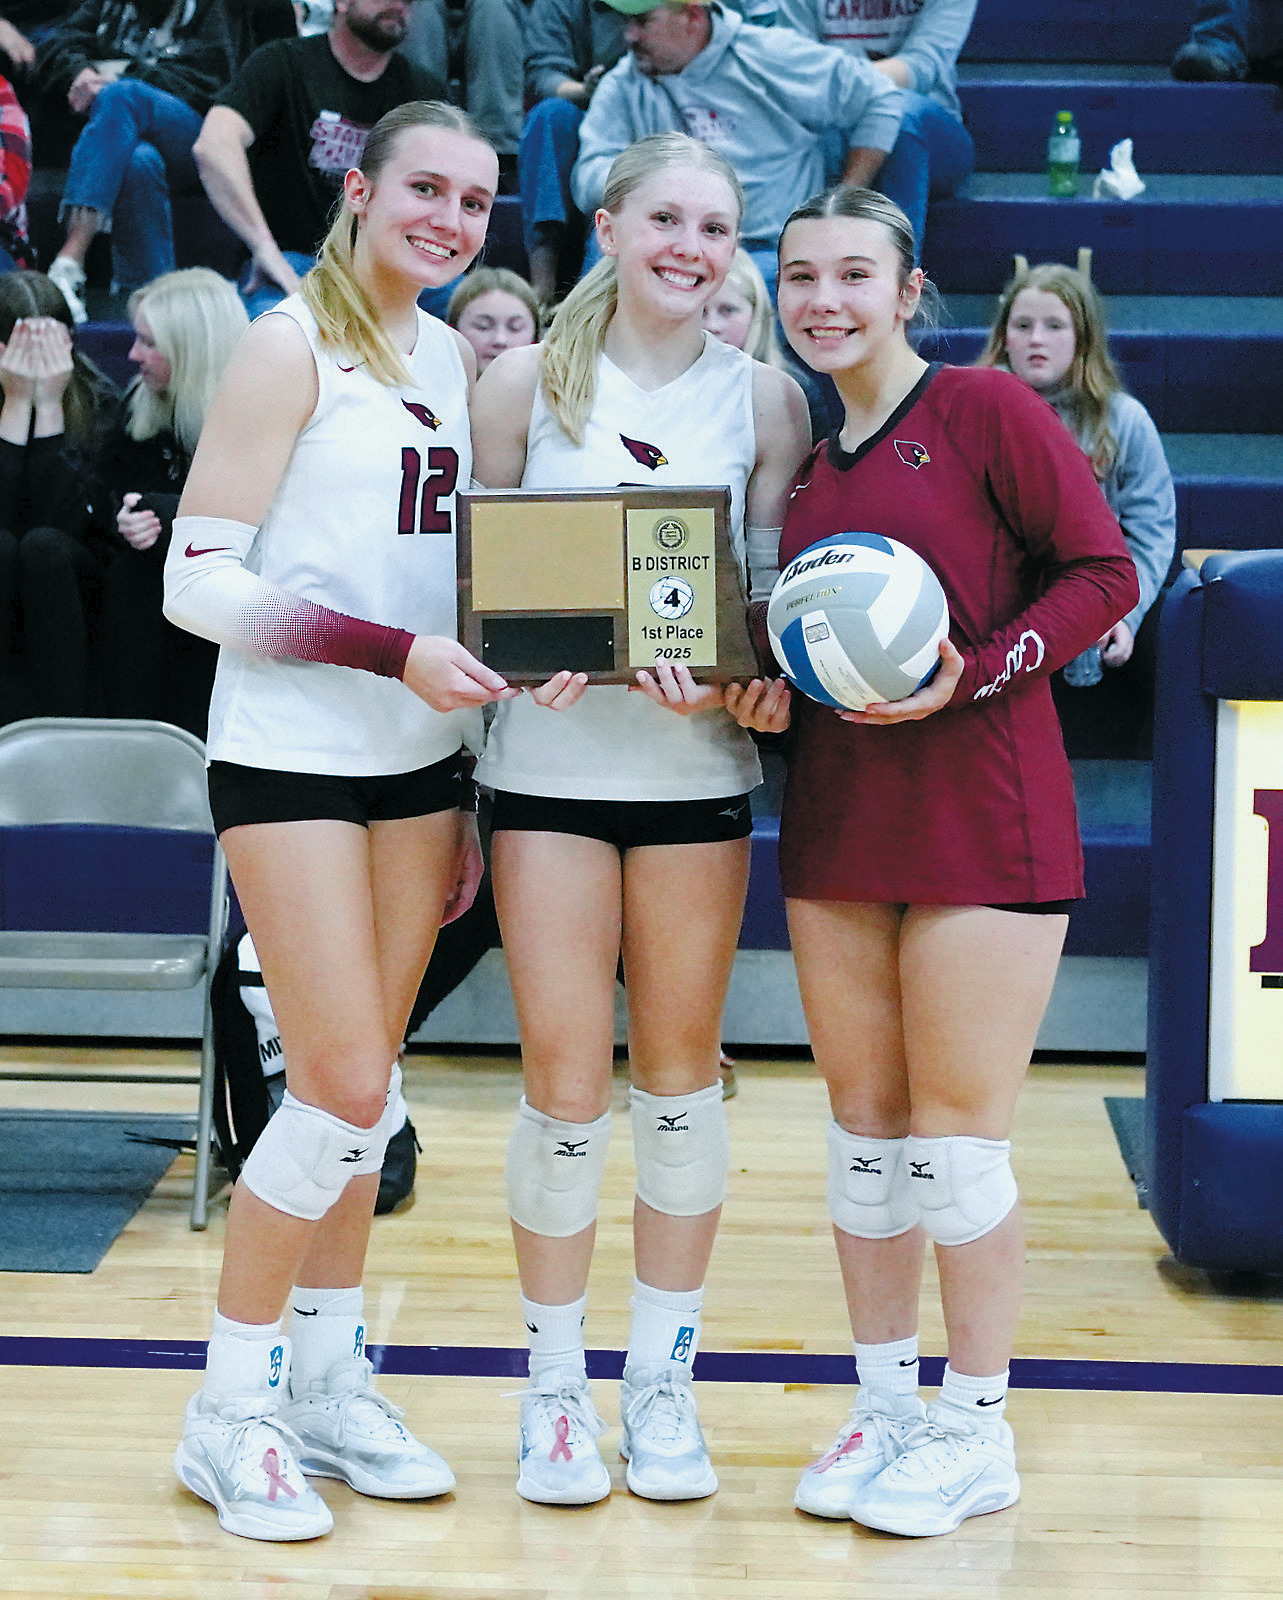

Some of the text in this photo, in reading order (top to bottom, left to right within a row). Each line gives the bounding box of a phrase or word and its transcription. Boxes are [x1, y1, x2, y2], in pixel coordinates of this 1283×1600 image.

[398, 447, 459, 534] 12
[632, 556, 709, 571] B DISTRICT
[781, 549, 855, 587] Baden
[663, 587, 681, 608] 4
[641, 625, 704, 640] 1st Place
[654, 647, 692, 659] 2025
[260, 1036, 282, 1062] MI
